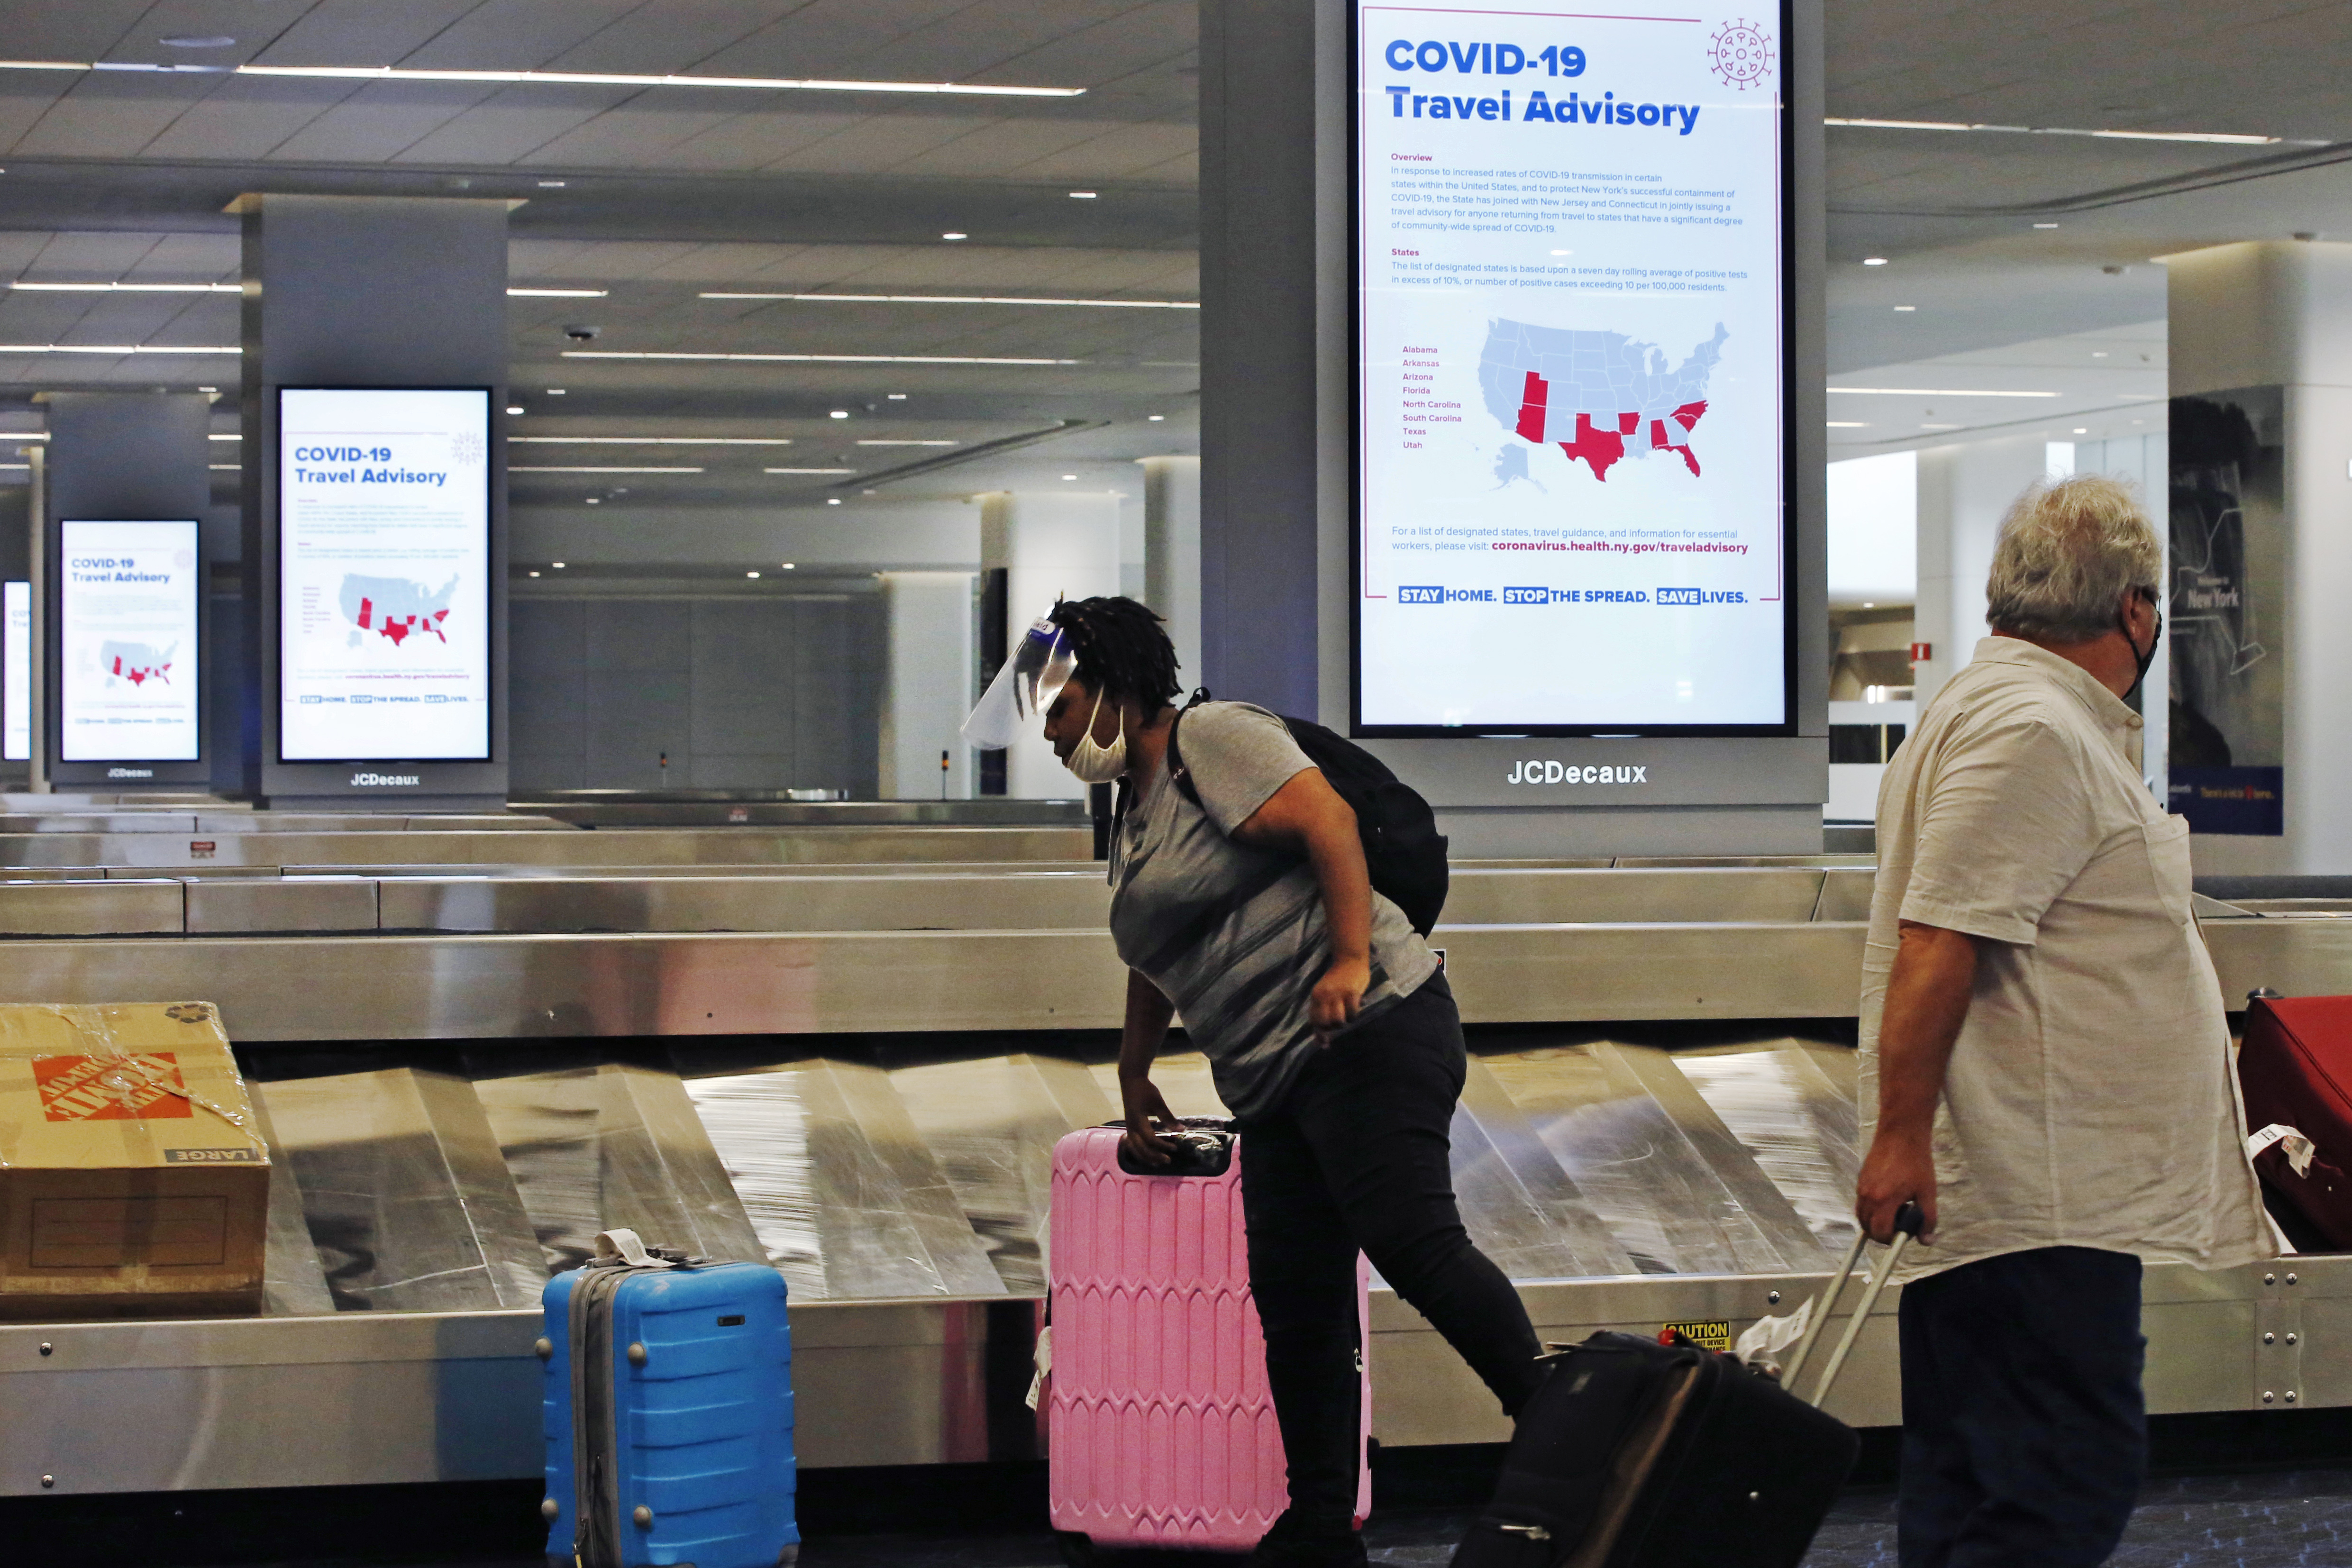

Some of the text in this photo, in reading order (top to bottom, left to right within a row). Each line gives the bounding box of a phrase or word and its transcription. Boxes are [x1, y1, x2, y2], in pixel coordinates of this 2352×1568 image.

[1385, 39, 1586, 77] COVID-19
[1385, 85, 1700, 136] Travel Advisory
[1391, 153, 1432, 162] Overview
[1391, 165, 1662, 182] In response to increased rates of COVID-19 transmission in certain
[1391, 180, 1735, 199] states within the United States, and to protect New York's successful containment of
[1391, 193, 1434, 203] COVID-19,
[1436, 195, 1450, 203] the
[1452, 195, 1474, 204] State
[1476, 196, 1491, 204] has
[1492, 196, 1519, 207] joined
[1521, 197, 1539, 206] with
[1540, 197, 1560, 206] New
[1561, 198, 1589, 209] Jersey
[1591, 200, 1607, 208] and
[1608, 200, 1658, 209] Connecticut
[1659, 201, 1668, 210] in
[1668, 201, 1694, 212] jointly
[1695, 202, 1723, 213] issuing
[1391, 207, 1415, 216] travel
[1416, 208, 1453, 219] advisory
[1454, 209, 1466, 217] for
[1468, 210, 1499, 219] anyone
[1501, 210, 1539, 221] returning
[1541, 211, 1560, 219] from
[1561, 212, 1585, 220] travel
[1586, 213, 1595, 221] to
[1597, 213, 1622, 222] states
[1623, 213, 1640, 222] that
[1641, 214, 1662, 223] have
[1670, 215, 1712, 225] significant
[1713, 217, 1743, 227] degree
[1391, 220, 1557, 233] of community-wide spread of COVID-19.
[1391, 248, 1420, 256] States
[1391, 261, 1408, 270] The
[1410, 262, 1422, 271] list
[1424, 262, 1433, 271] of
[1434, 262, 1481, 273] designated
[1483, 264, 1509, 273] states
[1511, 264, 1517, 273] is
[1520, 264, 1545, 273] based
[1547, 265, 1568, 275] upon
[1604, 267, 1621, 277] day
[1622, 268, 1647, 278] rolling
[1649, 270, 1683, 279] average
[1684, 269, 1694, 277] of
[1695, 270, 1727, 280] positive
[1728, 270, 1748, 279] tests
[1432, 276, 1442, 284] of
[1443, 276, 1462, 285] 10%,
[1475, 277, 1507, 286] number
[1509, 278, 1518, 286] of
[1520, 279, 1552, 288] positive
[1580, 281, 1623, 291] exceeding
[1625, 280, 1634, 290] 10
[1636, 283, 1650, 291] per
[1652, 282, 1686, 291] 100,000
[1687, 283, 1727, 292] residents.
[1402, 346, 1438, 354] Alabama
[1402, 359, 1440, 367] Arkansas
[1403, 386, 1431, 394] Florida
[1403, 400, 1461, 409] North Carolina
[1403, 414, 1462, 422] South Carolina
[1403, 441, 1422, 449] Utah
[295, 447, 392, 462] COVID-19
[295, 468, 447, 487] Travel Advisory
[1392, 526, 1408, 536] For
[1419, 526, 1432, 536] list
[1434, 527, 1444, 536] of
[1446, 527, 1498, 538] designated
[1501, 528, 1532, 538] states,
[1533, 528, 1559, 537] travel
[1562, 528, 1607, 539] guidance,
[1609, 528, 1627, 538] and
[1629, 528, 1680, 538] information
[1682, 529, 1696, 538] for
[1697, 529, 1738, 538] essential
[1393, 542, 1432, 550] workers,
[1435, 541, 1466, 552] please
[1492, 540, 1749, 555] coronavirus.health.ny.gov/traveladvisory
[72, 558, 134, 568] COVID-19
[72, 572, 170, 584] Travel Advisory
[1400, 589, 1749, 603] STAY HOME. STOP THE SPREAD. SAVE LIVES.
[1507, 759, 1648, 785] JCDecaux
[351, 773, 420, 786] JCDecaux
[176, 1150, 249, 1161] LARGE
